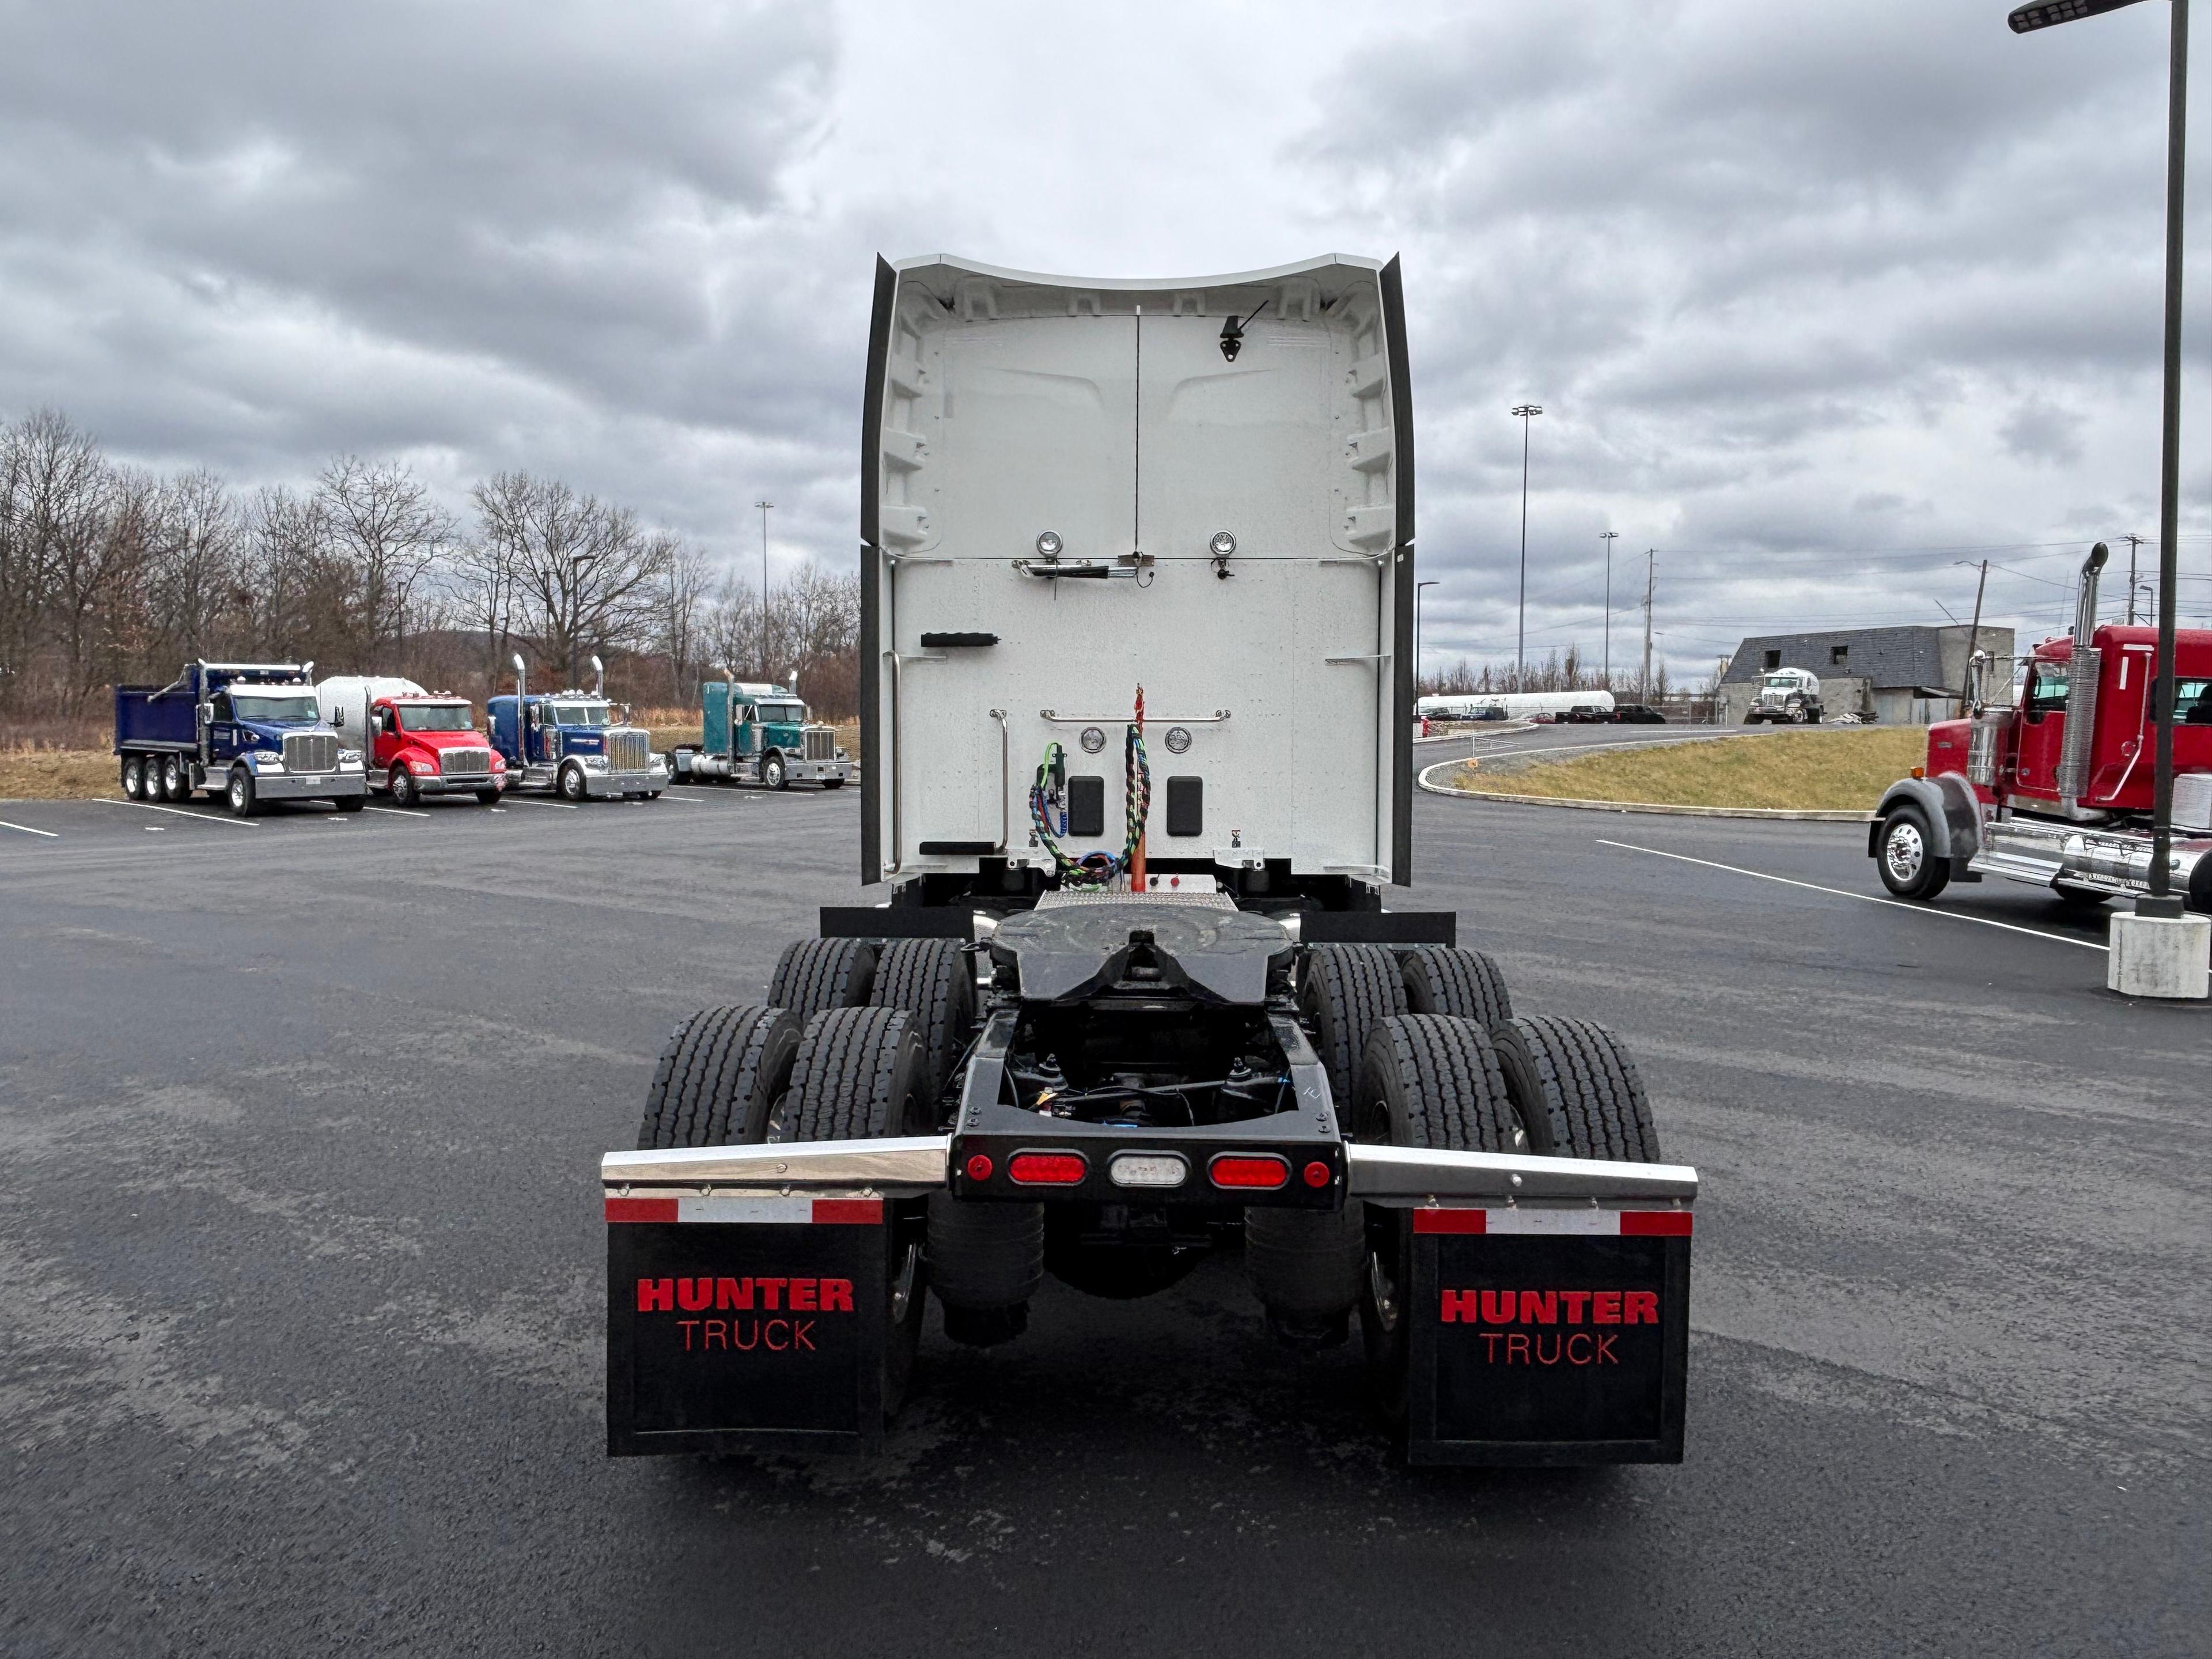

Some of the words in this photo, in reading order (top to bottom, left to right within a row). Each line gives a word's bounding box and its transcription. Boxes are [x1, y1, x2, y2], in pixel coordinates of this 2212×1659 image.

[638, 1278, 853, 1312] HUNTER
[1441, 1290, 1658, 1324] HUNTER
[677, 1320, 816, 1351] TRUCK
[1480, 1333, 1619, 1365] TRUCK
